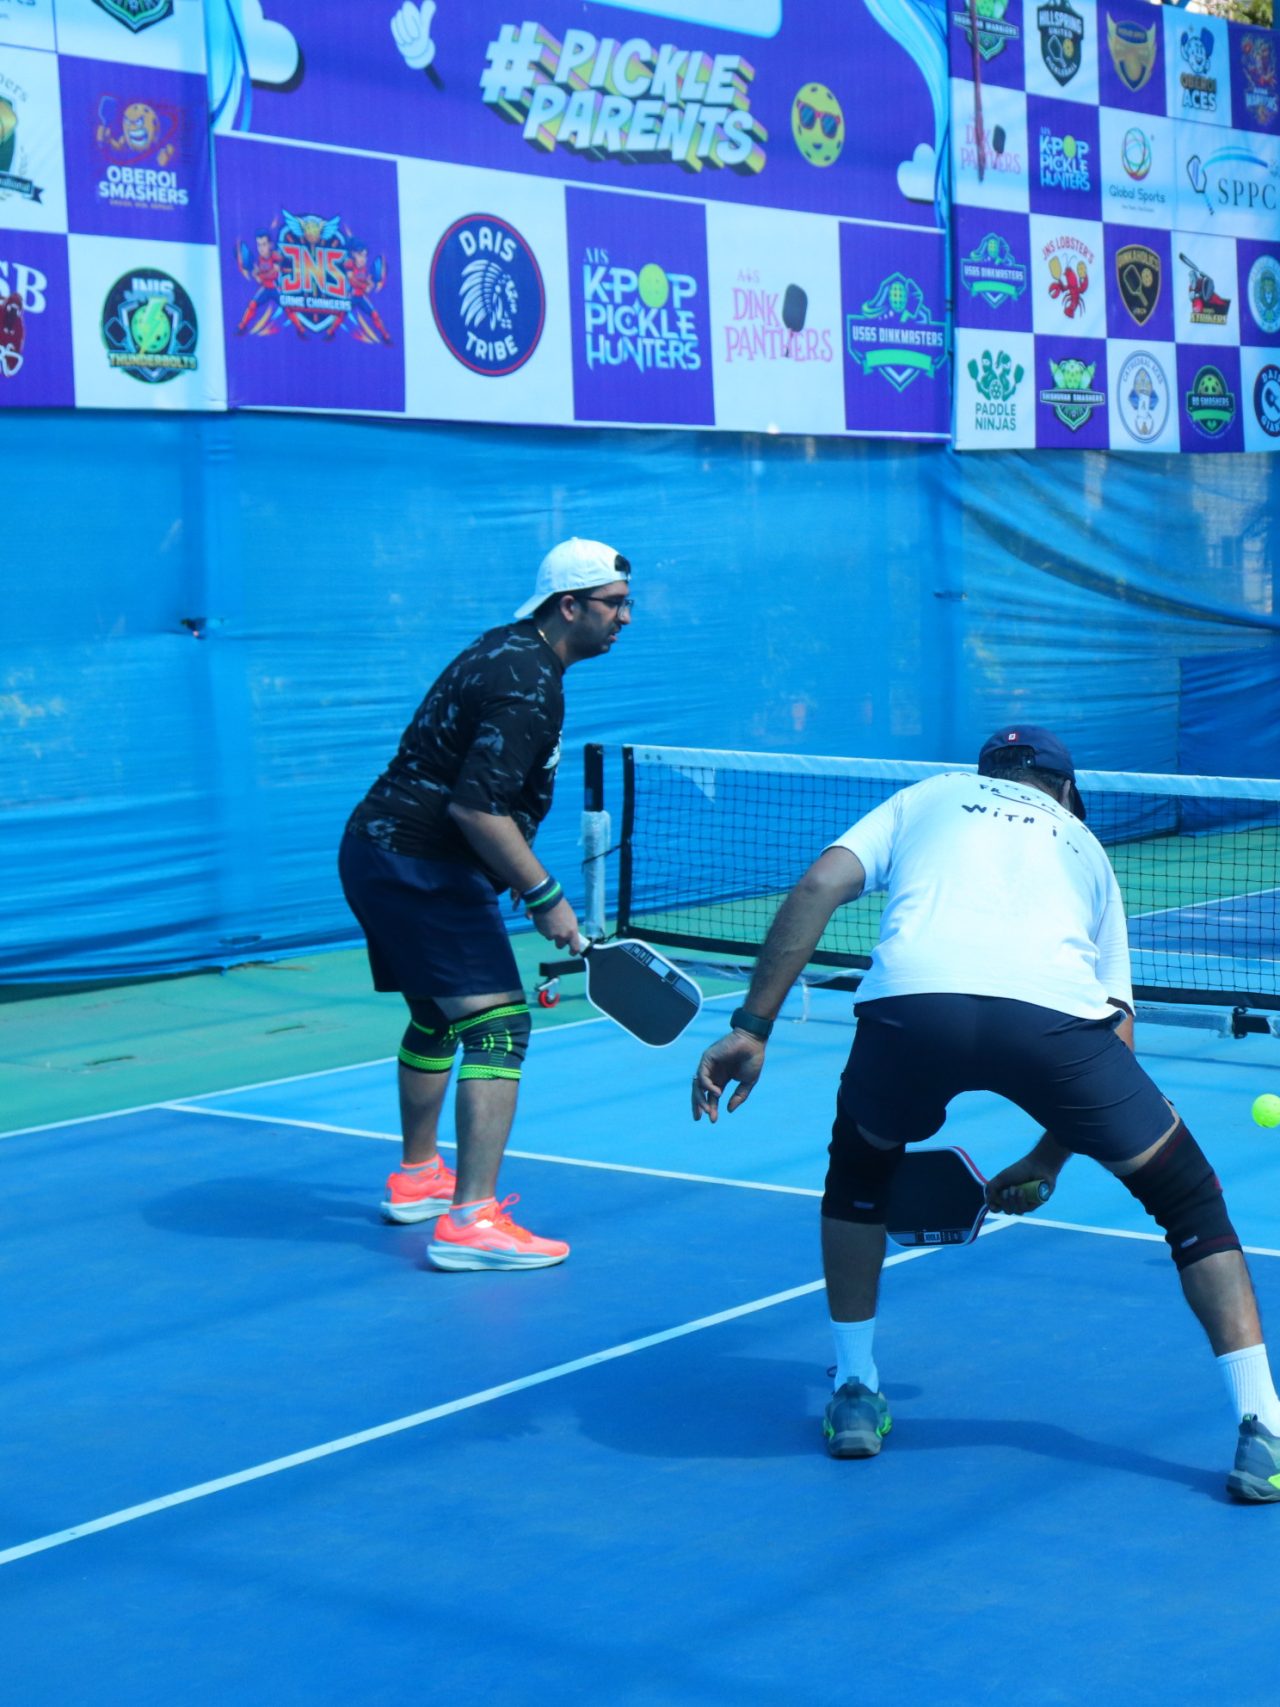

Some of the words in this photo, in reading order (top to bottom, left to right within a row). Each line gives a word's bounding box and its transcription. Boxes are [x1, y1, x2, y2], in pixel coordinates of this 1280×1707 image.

[480, 21, 746, 105] #PICKLE
[1182, 89, 1218, 112] ACES
[522, 85, 758, 166] PARENTS
[106, 165, 177, 188] OBEROI
[1040, 155, 1088, 174] PICKLE
[99, 181, 189, 205] SMASHERS
[1041, 169, 1090, 191] HUNTERS
[1109, 184, 1135, 199] Global
[1137, 187, 1166, 204] Sports
[1217, 177, 1278, 211] SPPC
[458, 226, 517, 262] DAIS
[279, 244, 347, 298] JNS
[584, 300, 698, 340] PICKLE
[732, 287, 783, 328] DINK
[464, 331, 518, 361] TRIBE
[724, 325, 834, 363] PANTHERS
[852, 325, 878, 342] USGS
[878, 327, 944, 347] DINKMASTERS
[586, 333, 701, 373] HUNTERS
[975, 402, 1017, 416] PADDLE
[975, 416, 1017, 431] NINJAS
